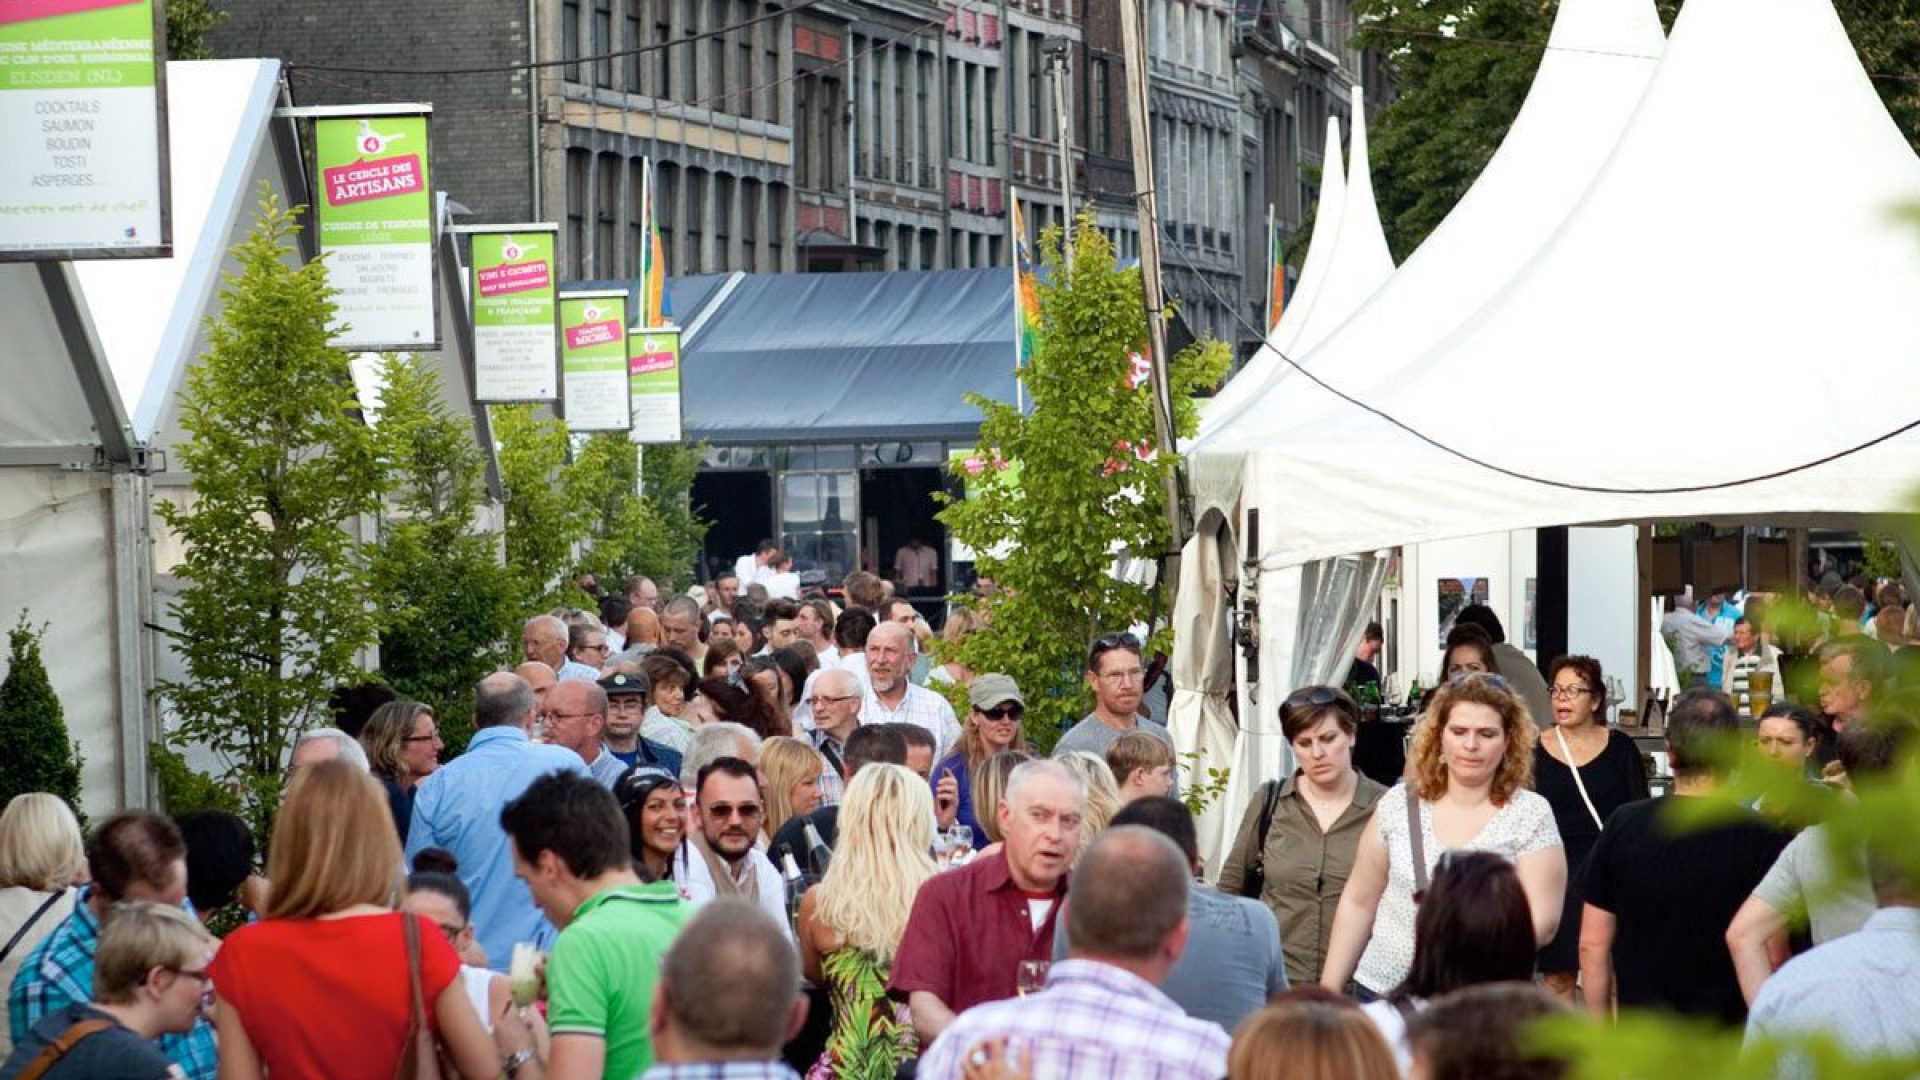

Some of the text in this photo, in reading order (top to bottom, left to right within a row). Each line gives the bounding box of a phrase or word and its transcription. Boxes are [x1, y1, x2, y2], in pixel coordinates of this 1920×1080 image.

[87, 69, 122, 83] (NL)
[34, 101, 100, 115] COCKTAILS
[41, 119, 94, 132] SAUMON
[46, 138, 91, 151] BOUDIN
[367, 138, 378, 150] 4
[52, 156, 87, 169] TOSTI
[332, 162, 413, 185] LE CERCLE DES
[335, 173, 416, 201] ARTISANS
